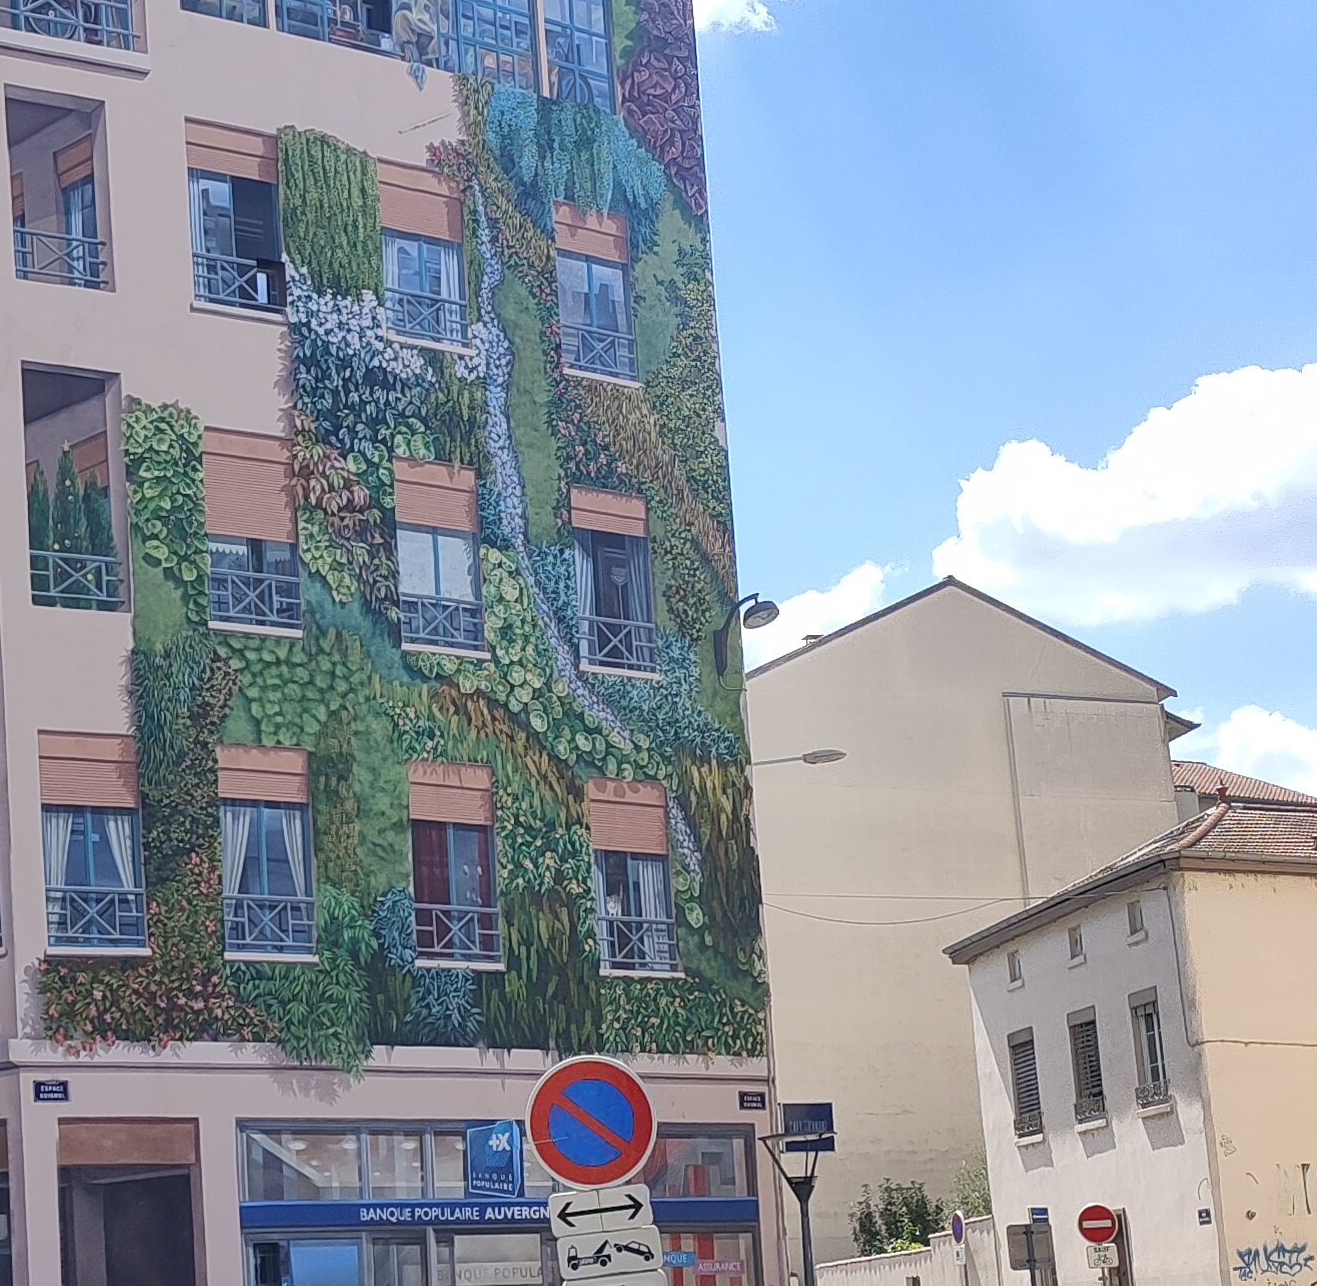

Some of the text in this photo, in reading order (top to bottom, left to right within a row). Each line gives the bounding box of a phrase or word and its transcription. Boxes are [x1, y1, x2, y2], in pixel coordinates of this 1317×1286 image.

[472, 1171, 513, 1181] BANQUE
[472, 1180, 513, 1191] POPULAIRE
[360, 1206, 549, 1223] BANQUE POPULAIRE AUVERGN
[663, 1254, 687, 1264] NQUE
[697, 1262, 741, 1271] ASSURANCE
